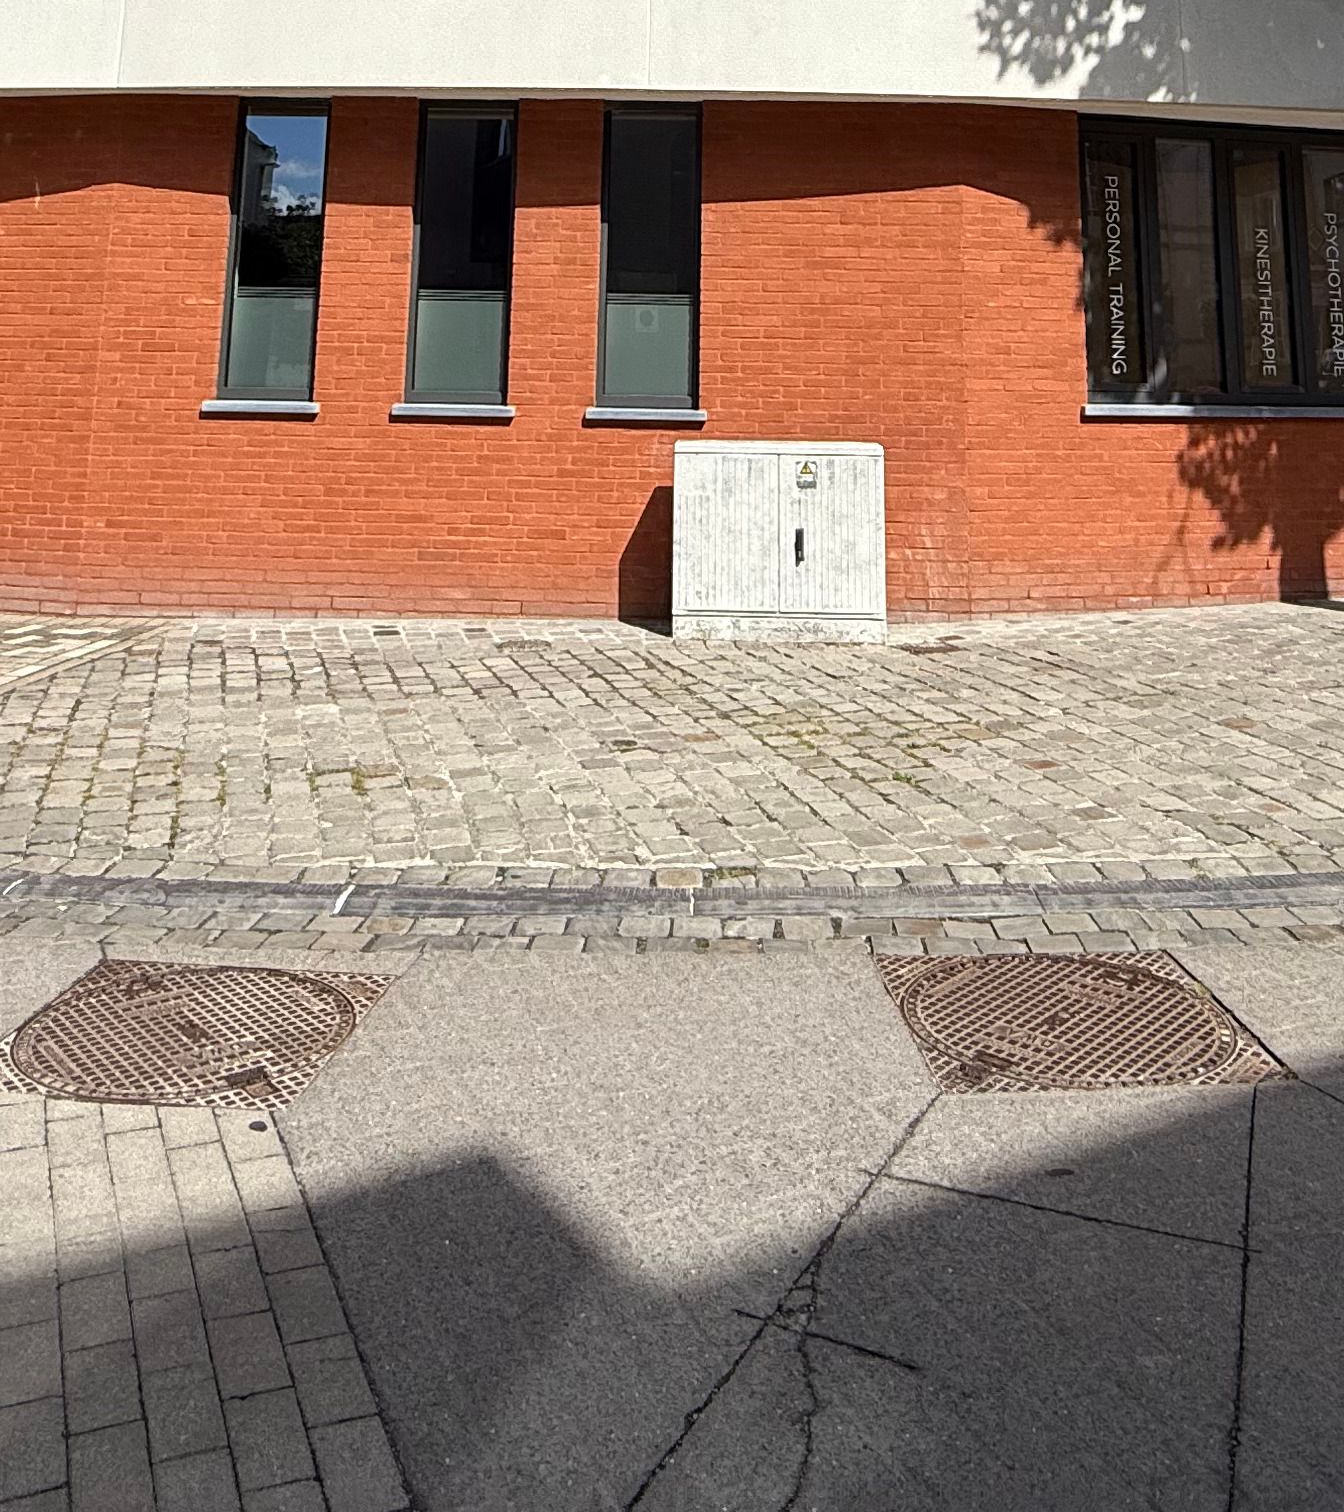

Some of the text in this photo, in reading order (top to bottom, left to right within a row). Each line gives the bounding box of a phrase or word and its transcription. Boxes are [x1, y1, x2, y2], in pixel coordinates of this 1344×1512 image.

[1104, 175, 1128, 375] PERSONAL TRAINING
[1255, 227, 1277, 377] KINESITHERAPIE
